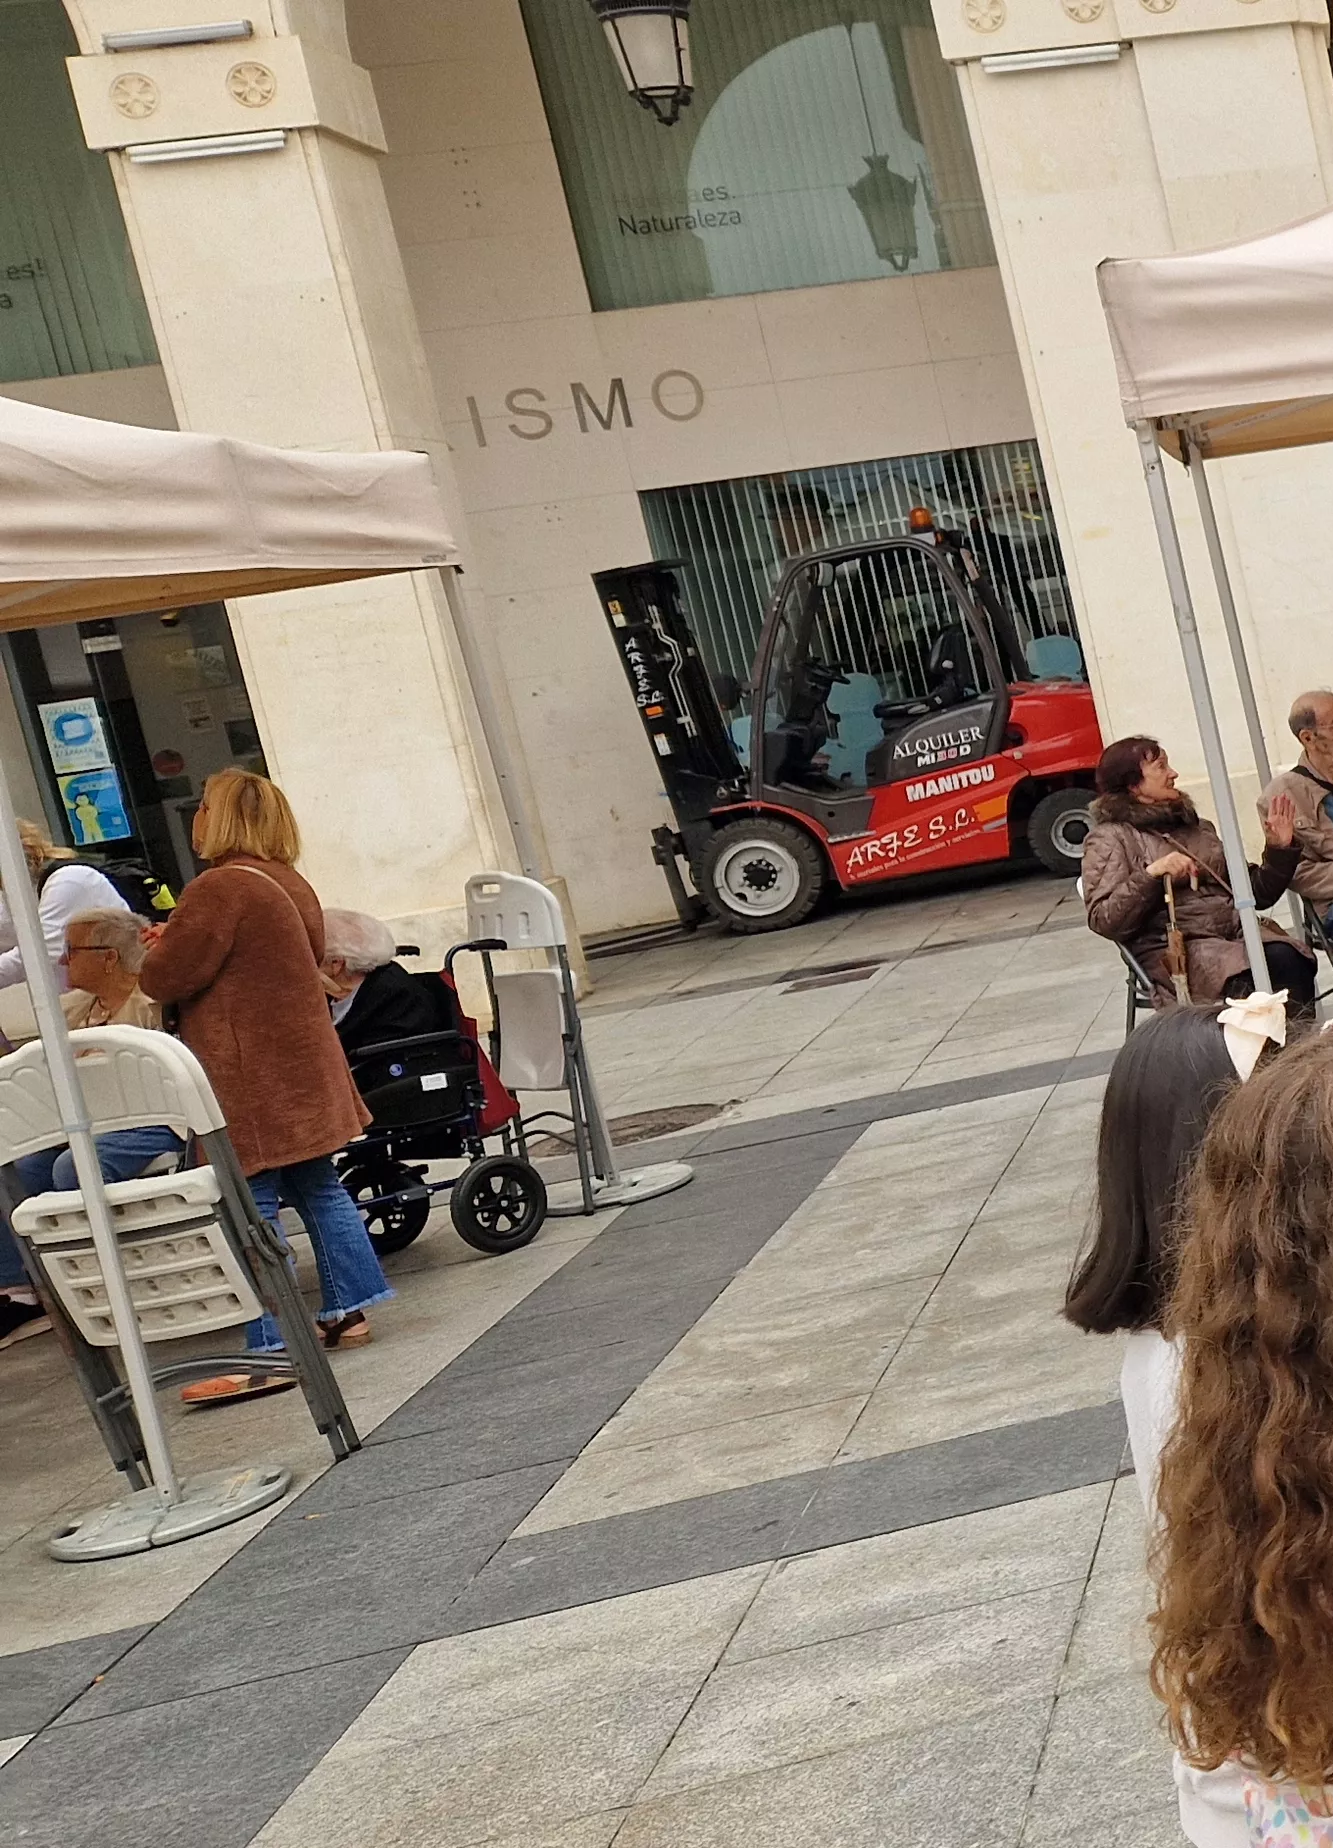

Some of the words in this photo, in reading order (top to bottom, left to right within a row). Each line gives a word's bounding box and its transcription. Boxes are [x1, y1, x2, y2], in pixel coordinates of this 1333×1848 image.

[617, 208, 742, 237] Naturaleza
[464, 368, 704, 448] ISMO
[893, 725, 985, 760] ALQUILER
[905, 764, 995, 803] MANITOU
